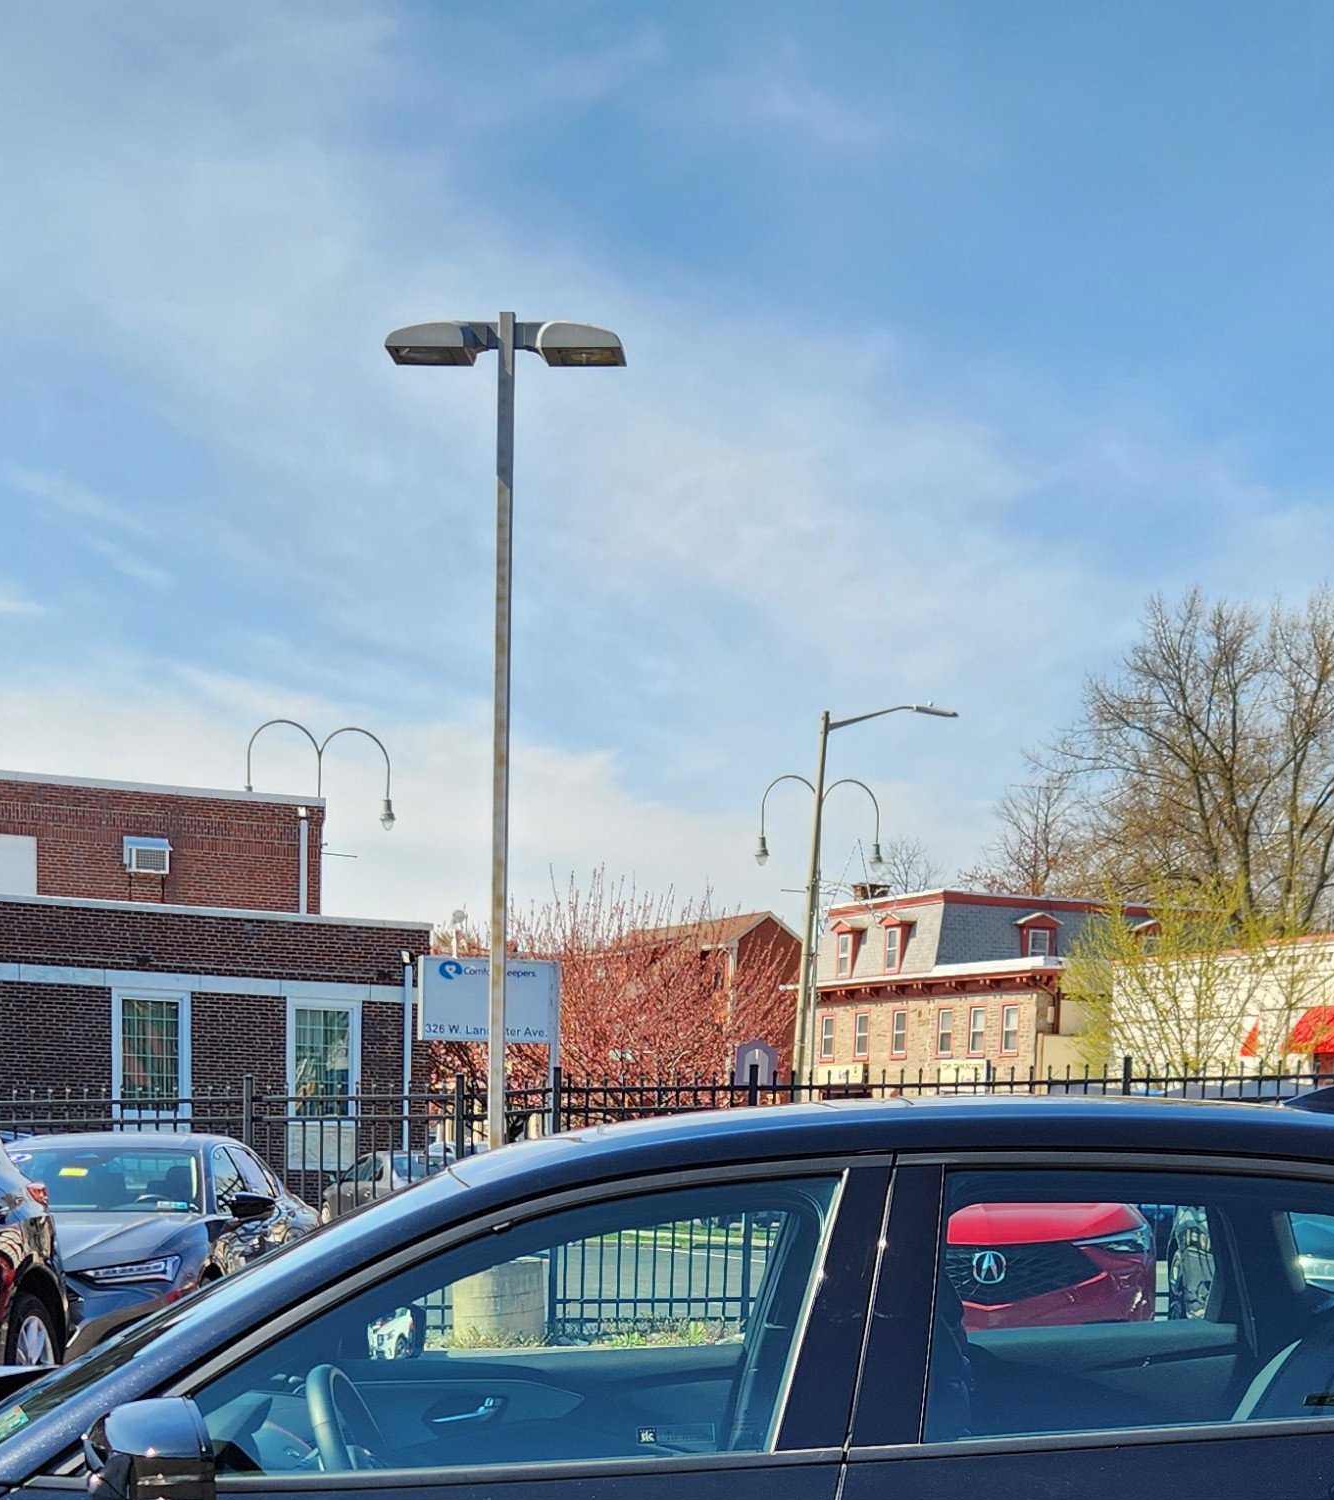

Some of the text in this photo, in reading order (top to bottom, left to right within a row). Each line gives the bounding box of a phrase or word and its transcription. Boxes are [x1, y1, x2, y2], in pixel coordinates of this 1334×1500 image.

[506, 969, 537, 979] eepers
[425, 1023, 548, 1038] 326 W. Lanter Ave.
